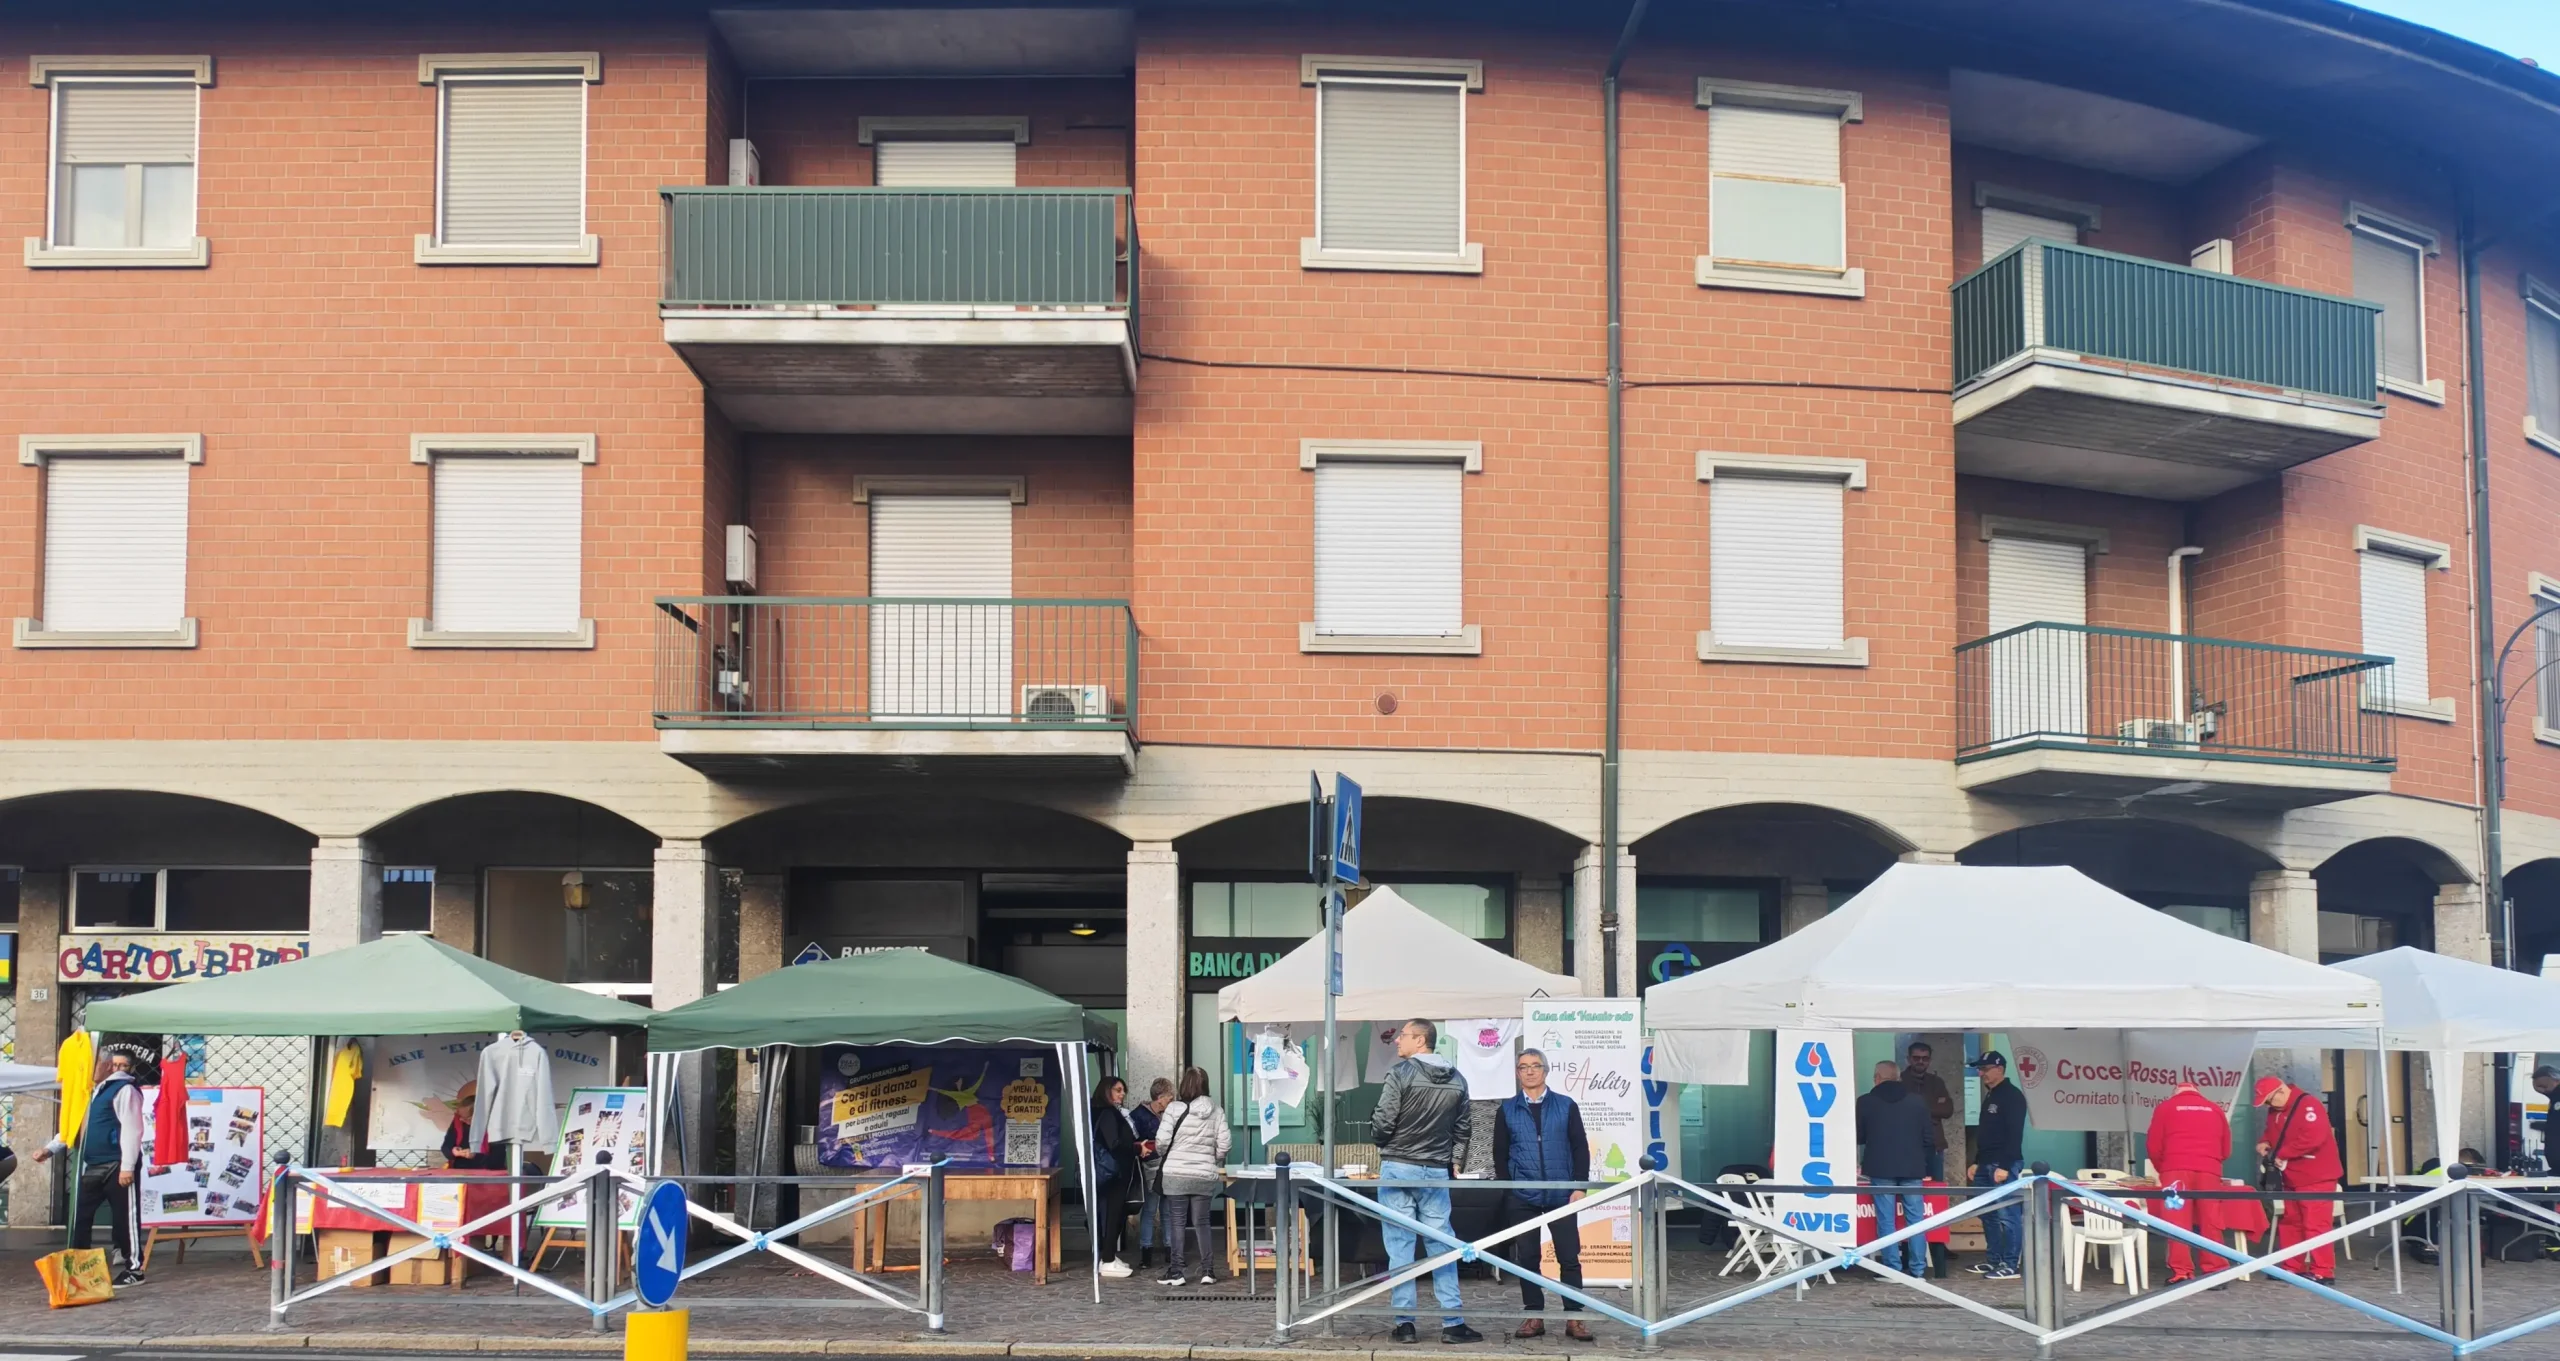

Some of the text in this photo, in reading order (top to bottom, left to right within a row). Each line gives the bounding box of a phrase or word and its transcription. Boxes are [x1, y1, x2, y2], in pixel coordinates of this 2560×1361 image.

[1190, 952, 1256, 977] BANCA
[33, 989, 45, 999] 36
[1532, 1010, 1558, 1021] Casa
[1558, 1010, 1576, 1021] del
[555, 1049, 600, 1068] ONLUS
[2056, 1058, 2122, 1081] Croce
[2126, 1059, 2178, 1086] Rossa
[841, 1079, 917, 1105] Corsi di danza
[1013, 1085, 1039, 1093] VIENI A
[2053, 1089, 2119, 1106] Comitato
[849, 1094, 907, 1116] e di fitness
[1008, 1095, 1042, 1104] PROVARE
[845, 1120, 856, 1129] per
[885, 1106, 910, 1119] ragazzi
[1014, 1105, 1043, 1114] GRATIS!
[869, 1119, 889, 1131] adulti
[1795, 1041, 1837, 1199] AVIS
[1782, 1211, 1850, 1233] AVIS
